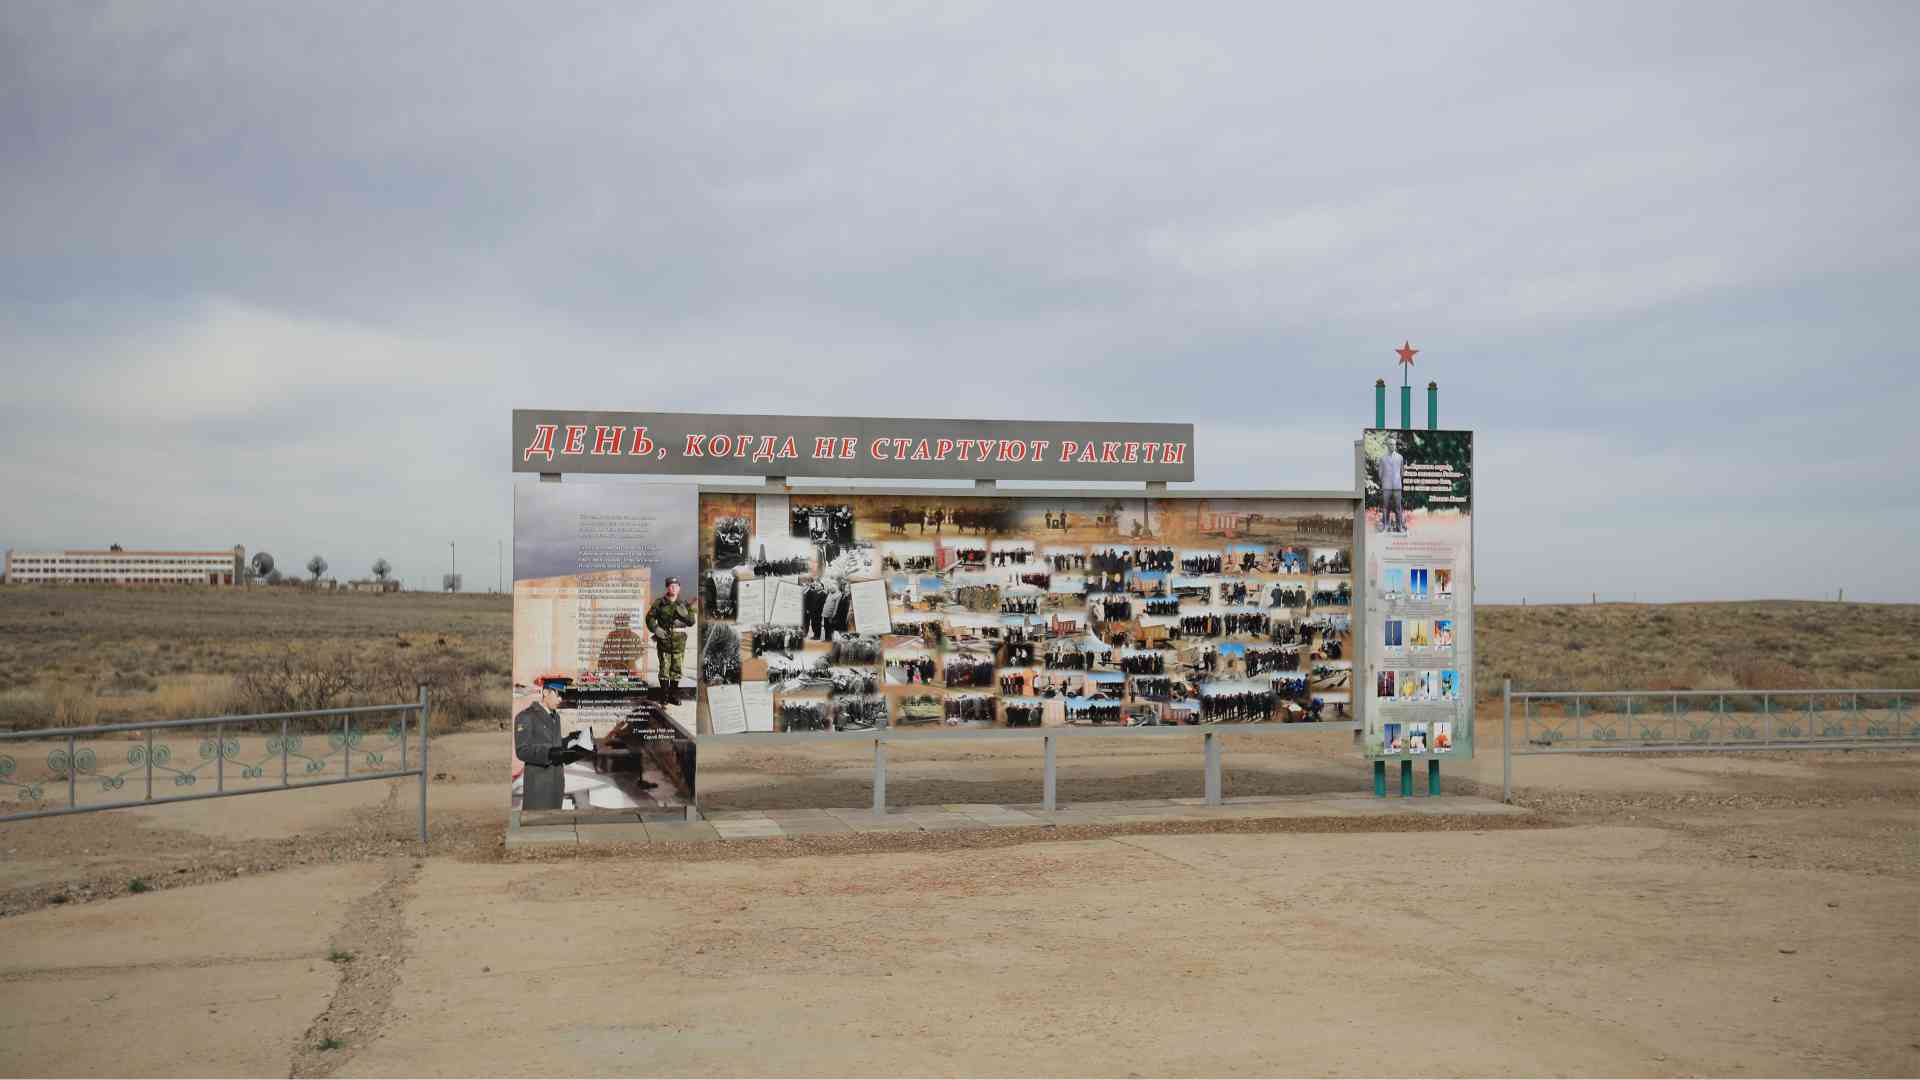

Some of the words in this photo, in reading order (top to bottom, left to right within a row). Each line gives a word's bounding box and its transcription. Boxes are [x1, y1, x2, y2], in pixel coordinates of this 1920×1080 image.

[524, 424, 667, 462] ДЕНЬ,
[683, 434, 799, 464] КОГДА
[812, 437, 858, 460] НЕ
[871, 438, 1049, 463] СТАРТУЮТ
[1059, 440, 1186, 464] РАКЕТЫ
